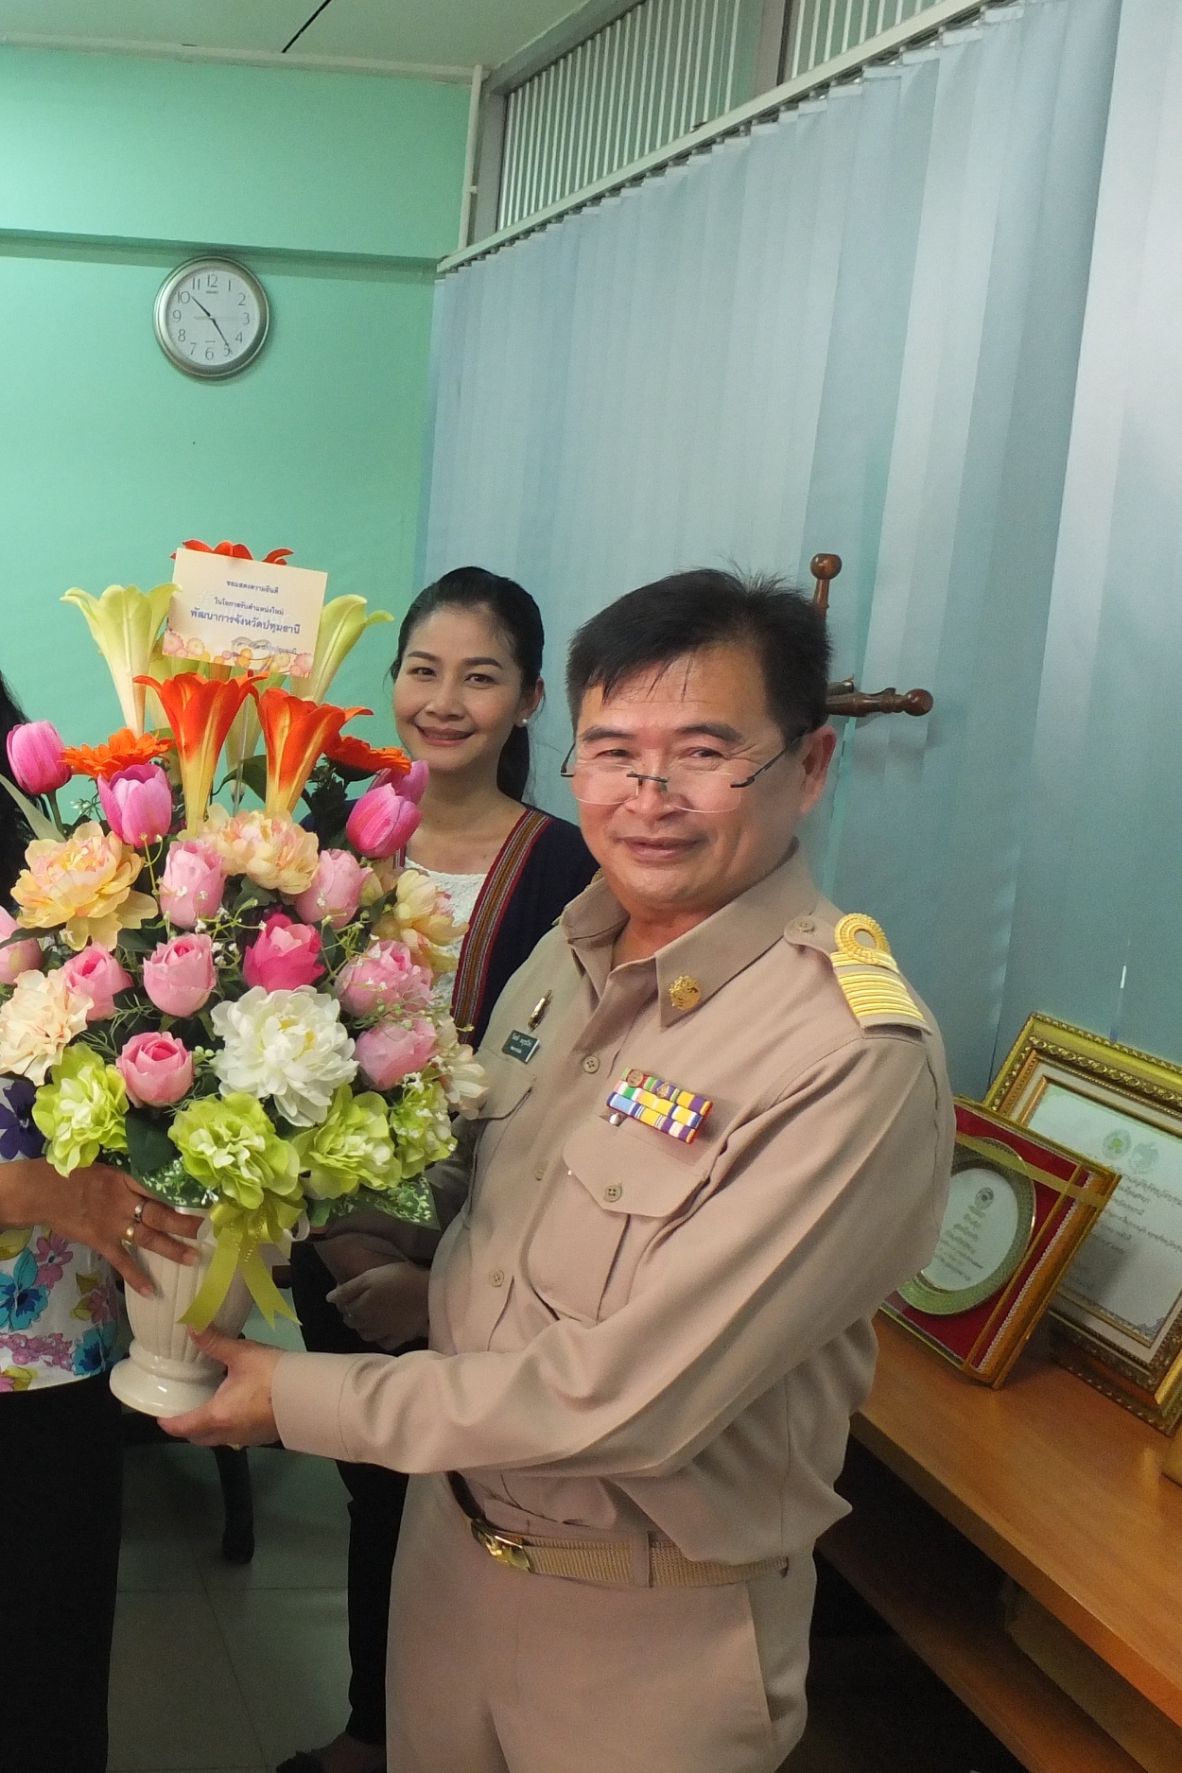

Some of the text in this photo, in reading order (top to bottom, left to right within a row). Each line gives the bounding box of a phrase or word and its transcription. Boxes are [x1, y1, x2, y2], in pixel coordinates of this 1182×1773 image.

[192, 277, 201, 290] 11
[207, 274, 218, 288] 12
[177, 290, 191, 304] 10
[238, 293, 246, 306] 2
[172, 310, 182, 323] 9
[242, 312, 250, 325] 3
[178, 329, 186, 342] 8
[235, 332, 243, 344] 4
[190, 342, 197, 356] 7
[205, 347, 214, 360] 6
[223, 345, 232, 357] 5
[190, 607, 301, 634] พัฒนาการจังหวัดปทุมธานี
